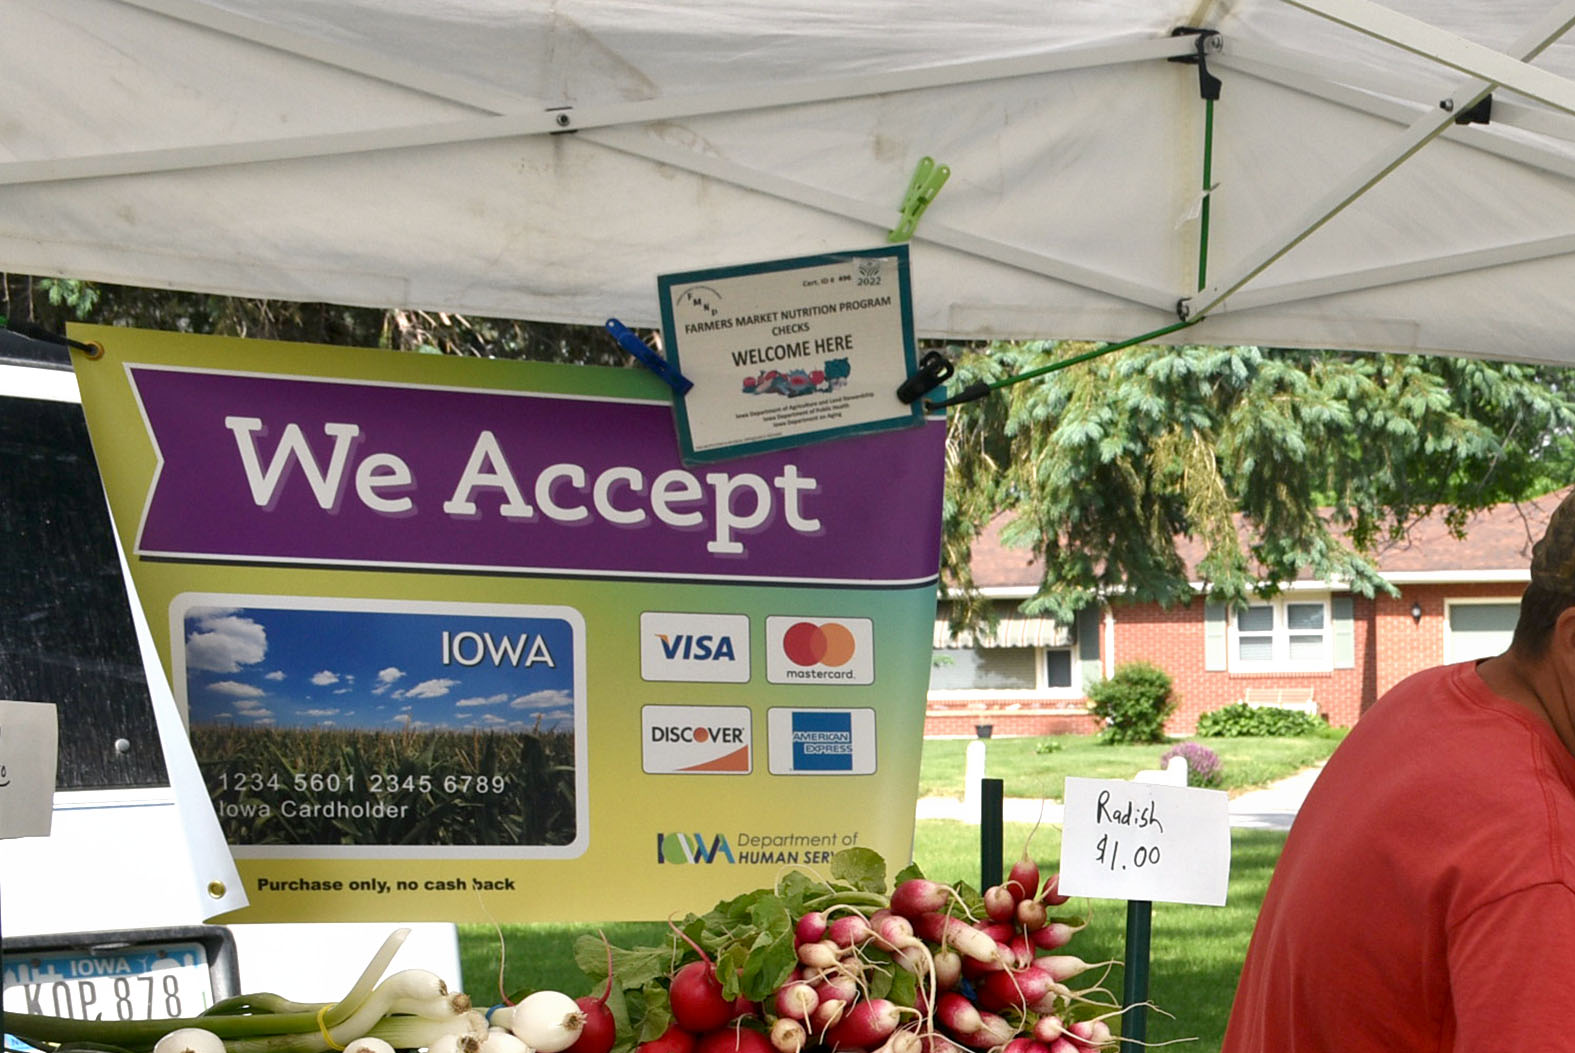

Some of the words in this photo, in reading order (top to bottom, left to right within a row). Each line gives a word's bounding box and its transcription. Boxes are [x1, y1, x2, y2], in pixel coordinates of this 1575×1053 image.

[857, 276, 882, 286] 2022
[685, 318, 734, 335] FARMERS
[735, 312, 778, 328] MARKET
[780, 304, 837, 321] NUTRITION
[839, 296, 892, 313] PROGRAM
[771, 322, 811, 337] CHECKS
[731, 342, 812, 368] WELCOME
[814, 334, 854, 357] HERE
[749, 406, 782, 418] Department
[777, 409, 809, 421] Department
[787, 415, 819, 426] Department
[225, 416, 413, 513] We
[444, 430, 822, 554] Accept
[442, 631, 556, 667] IOWA
[655, 634, 736, 662] VISA
[786, 669, 856, 680] mastercard
[651, 726, 745, 744] DISCOVER
[792, 732, 849, 742] AMERICAN
[804, 743, 853, 754] EXPRESS
[218, 772, 281, 792] 1234
[293, 773, 356, 792] 5601
[369, 774, 432, 793] 2345
[443, 775, 506, 794] 6789
[219, 801, 270, 818] Iowa
[281, 800, 408, 819] Cardholder
[1096, 790, 1164, 834] Radish
[657, 832, 737, 865] IOWA
[737, 832, 838, 849] Department
[841, 832, 860, 847] of
[738, 851, 799, 864] HUMAN
[1095, 833, 1161, 870] $1.00
[257, 877, 343, 892] Purchase
[348, 877, 391, 895] only,
[396, 879, 419, 891] no
[423, 877, 467, 891] cash
[472, 877, 516, 891] back
[70, 957, 132, 977] IOWA
[113, 974, 182, 1021] 878
